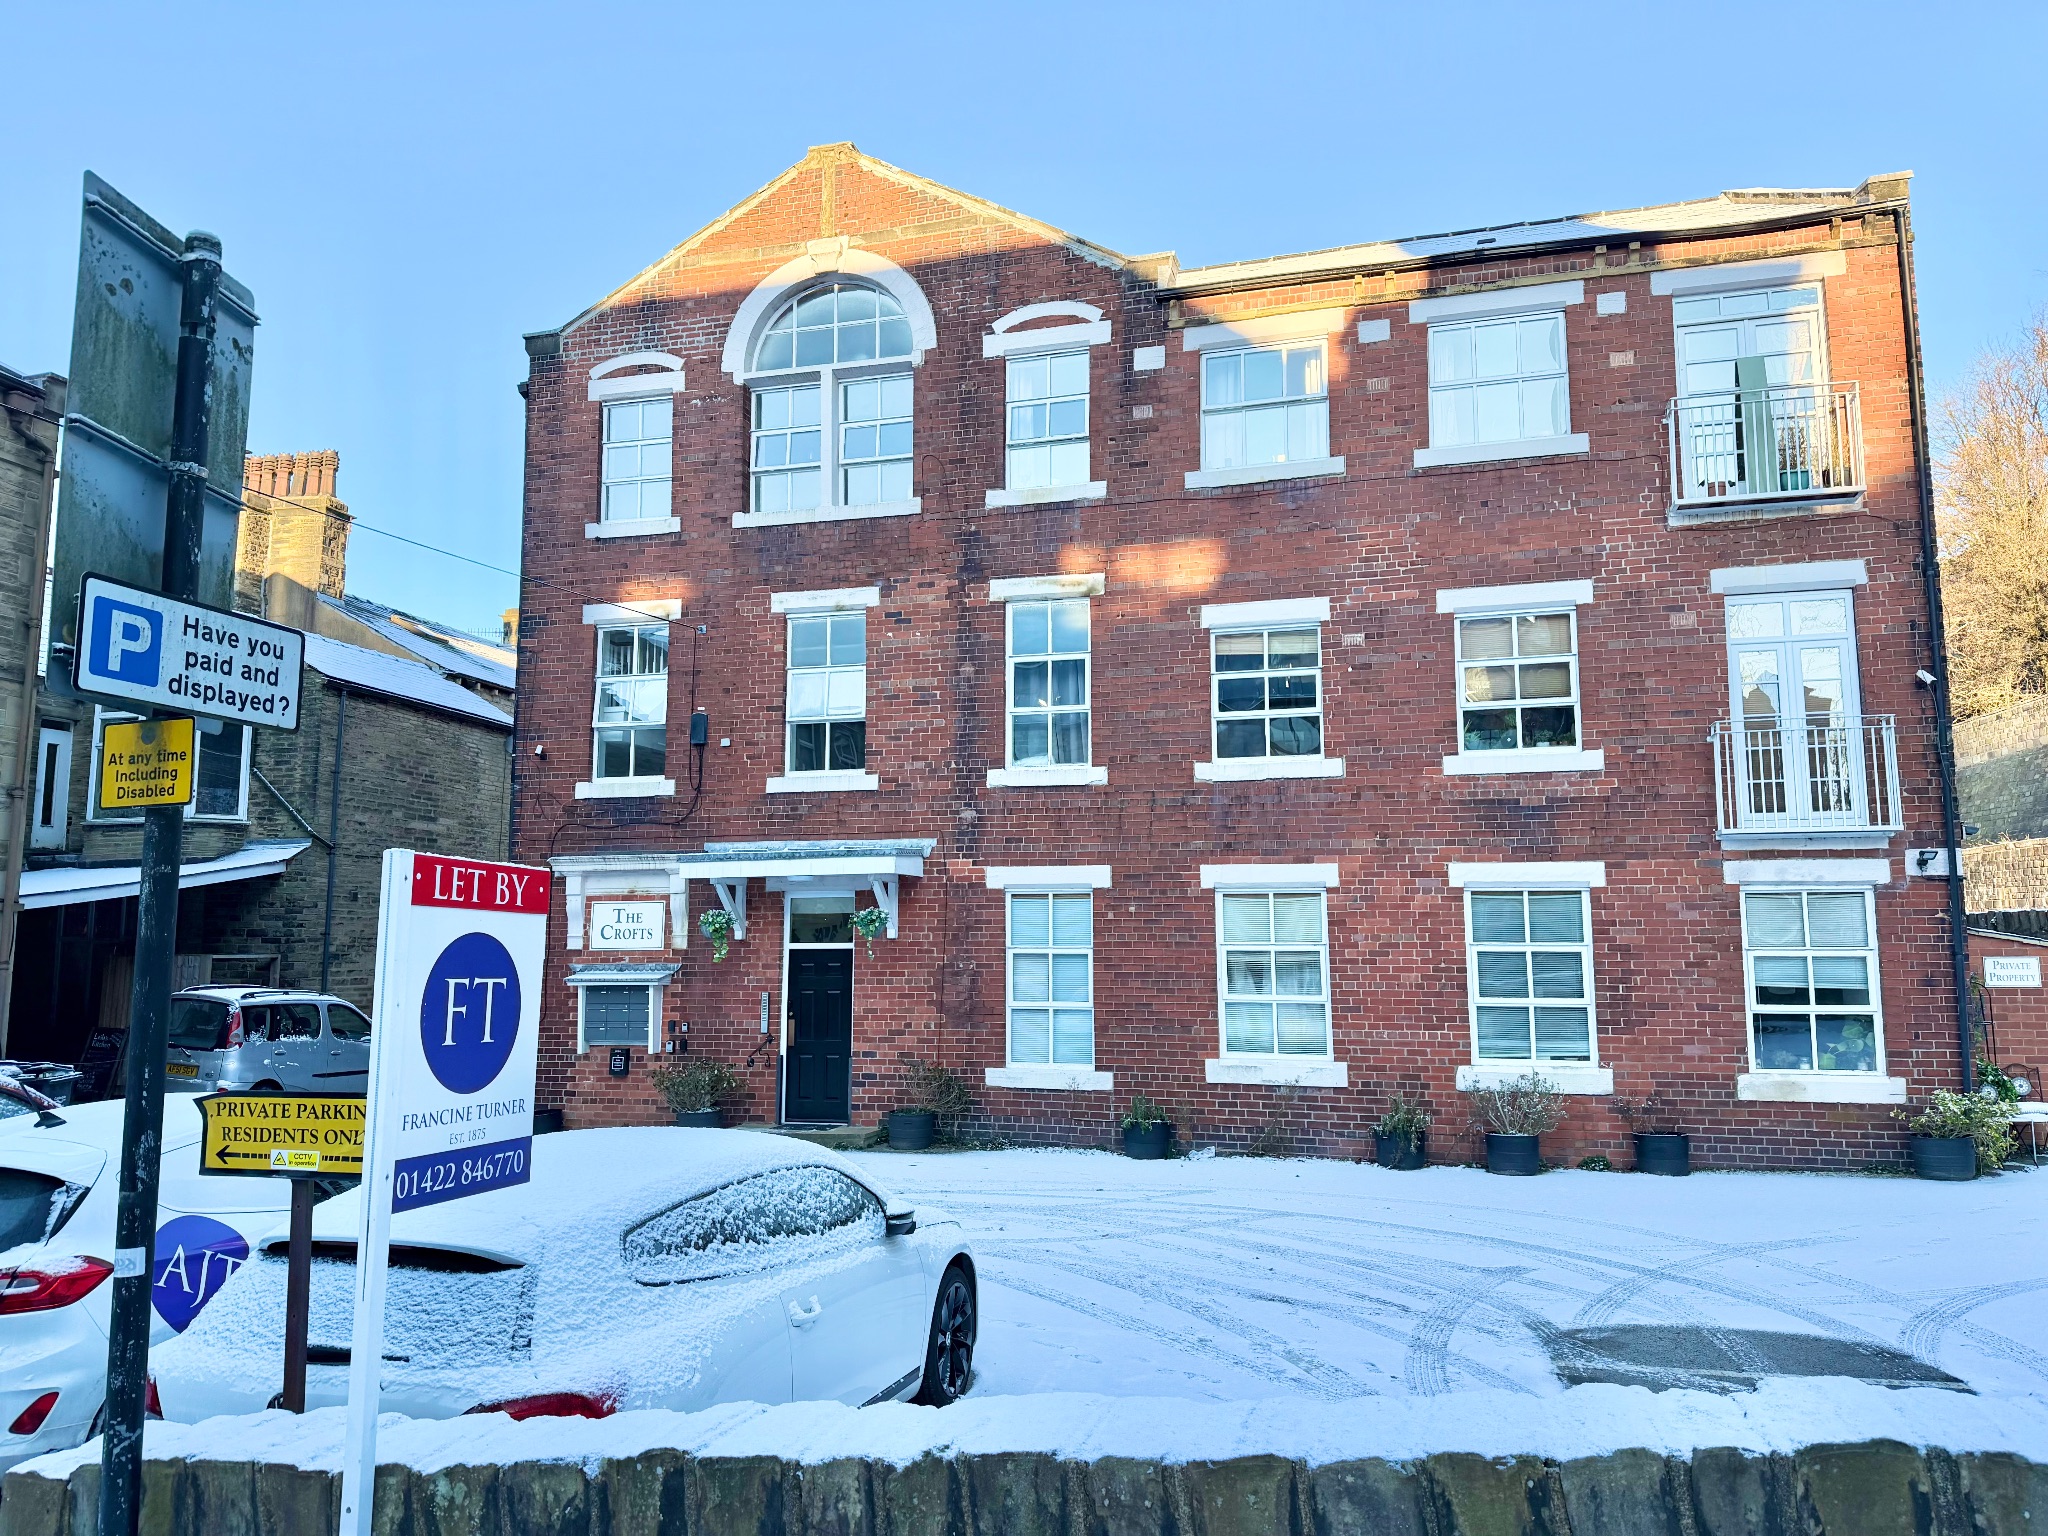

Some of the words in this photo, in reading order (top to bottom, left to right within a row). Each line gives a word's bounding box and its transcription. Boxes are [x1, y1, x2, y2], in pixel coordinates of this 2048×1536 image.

[107, 609, 152, 672] P
[183, 614, 239, 648] Have
[247, 637, 284, 660] you
[184, 650, 233, 677] paid
[240, 663, 279, 687] and
[168, 673, 290, 717] displayed?
[108, 753, 124, 766] At
[128, 754, 151, 768] any
[157, 750, 187, 763] time
[115, 767, 178, 783] Including
[116, 783, 175, 800] Disabled
[432, 864, 487, 903] LET
[494, 871, 530, 907] BY
[612, 908, 643, 924] THE
[600, 924, 653, 940] CROFTS
[1992, 960, 2032, 970] PRIVATE
[1989, 972, 2036, 982] PROPERTY
[441, 977, 507, 1046] FT
[215, 1101, 291, 1119] PRIVATE
[296, 1103, 367, 1120] PARKIN
[401, 1105, 473, 1131] FRANCINE
[476, 1098, 526, 1120] TURNER
[221, 1126, 319, 1145] RESIDENTS
[324, 1129, 365, 1145] ONL
[449, 1132, 465, 1145] EST.
[468, 1128, 486, 1142] 1875
[396, 1162, 456, 1199] 01422
[461, 1150, 524, 1185] 846770
